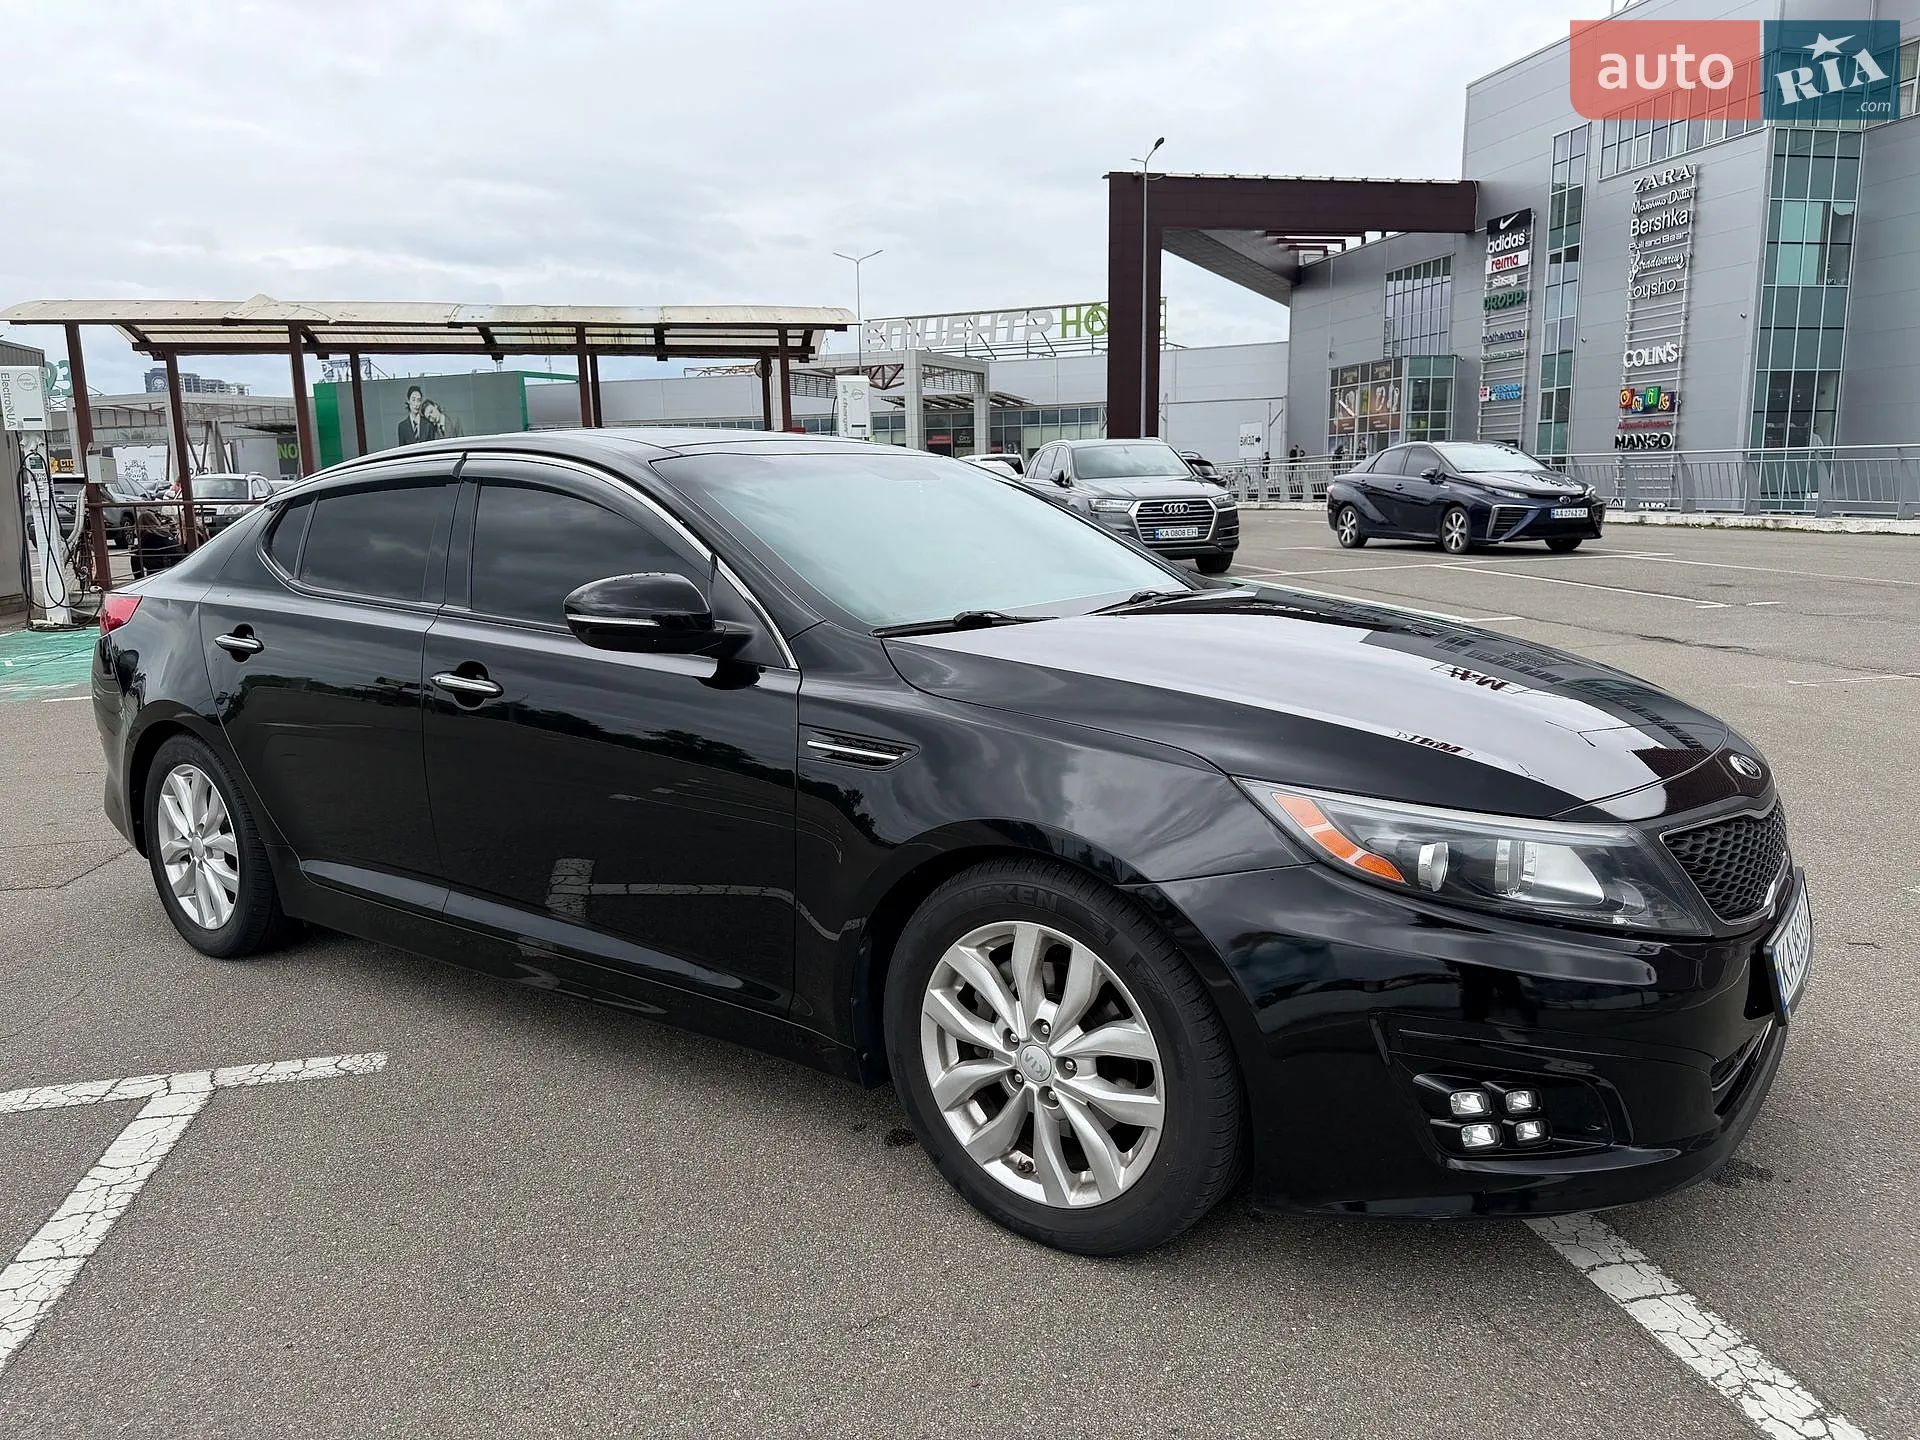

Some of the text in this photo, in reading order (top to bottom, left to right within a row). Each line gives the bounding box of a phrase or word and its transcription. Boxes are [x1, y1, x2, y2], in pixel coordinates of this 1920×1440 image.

[1632, 164, 1694, 194] ZARA
[1631, 198, 1667, 215] Massimo
[1630, 207, 1690, 237] Bershka
[1488, 230, 1526, 253] adidas
[1491, 254, 1519, 271] reima
[1633, 277, 1678, 300] oysho
[1623, 341, 1678, 368] COLIN'S
[1615, 432, 1673, 449] MANGO
